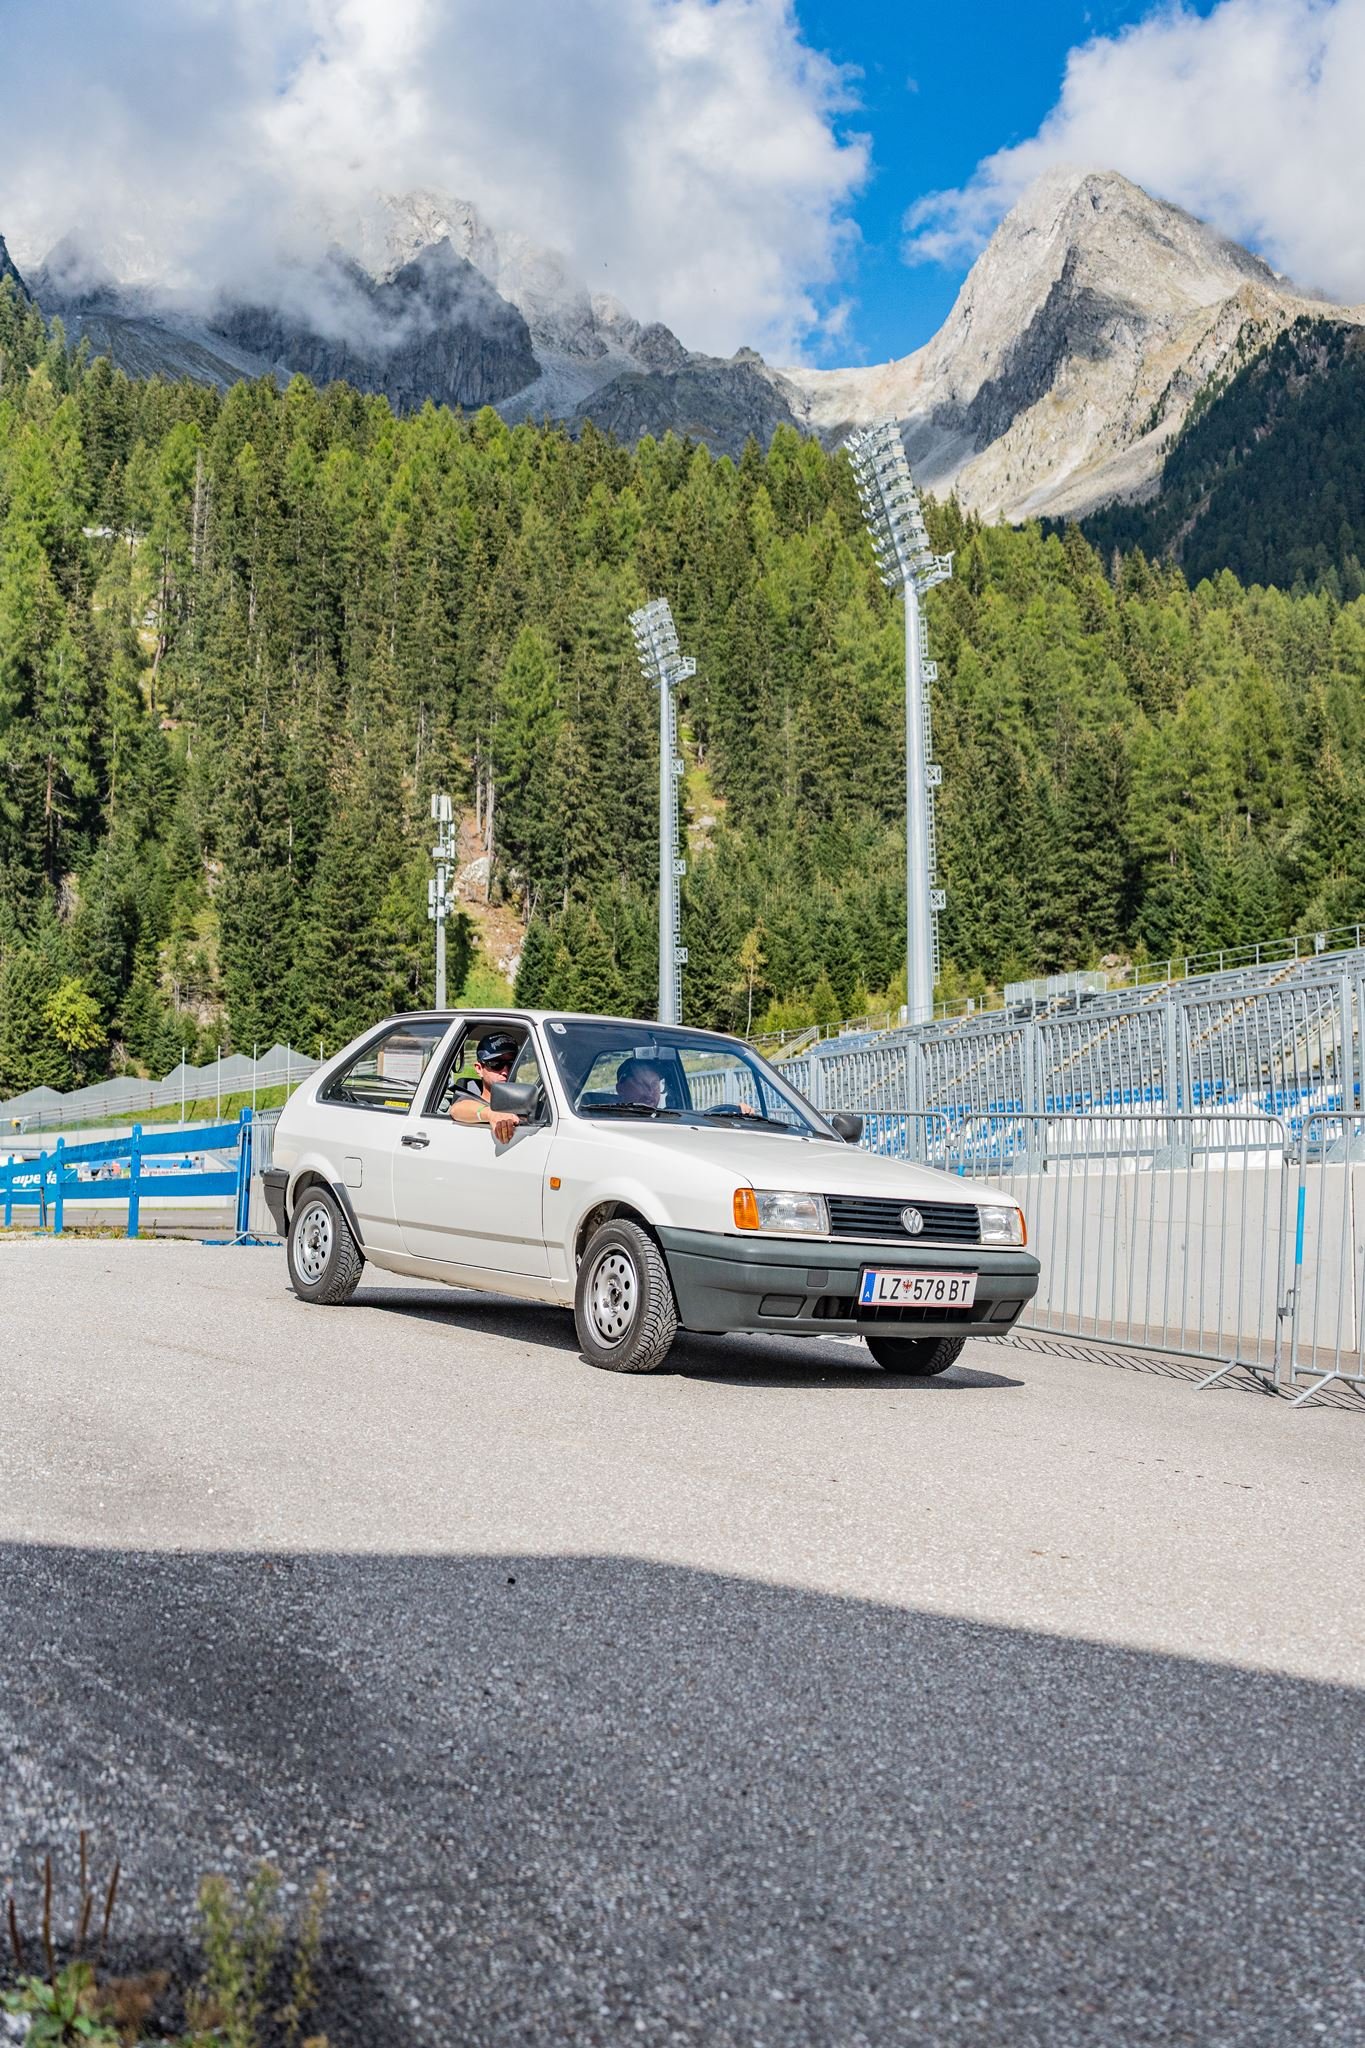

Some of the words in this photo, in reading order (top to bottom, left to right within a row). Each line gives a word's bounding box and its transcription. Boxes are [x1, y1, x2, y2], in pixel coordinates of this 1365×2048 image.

[12, 1170, 57, 1188] alpeia
[878, 1277, 902, 1300] LZ
[913, 1278, 945, 1301] 578
[948, 1279, 970, 1302] BT
